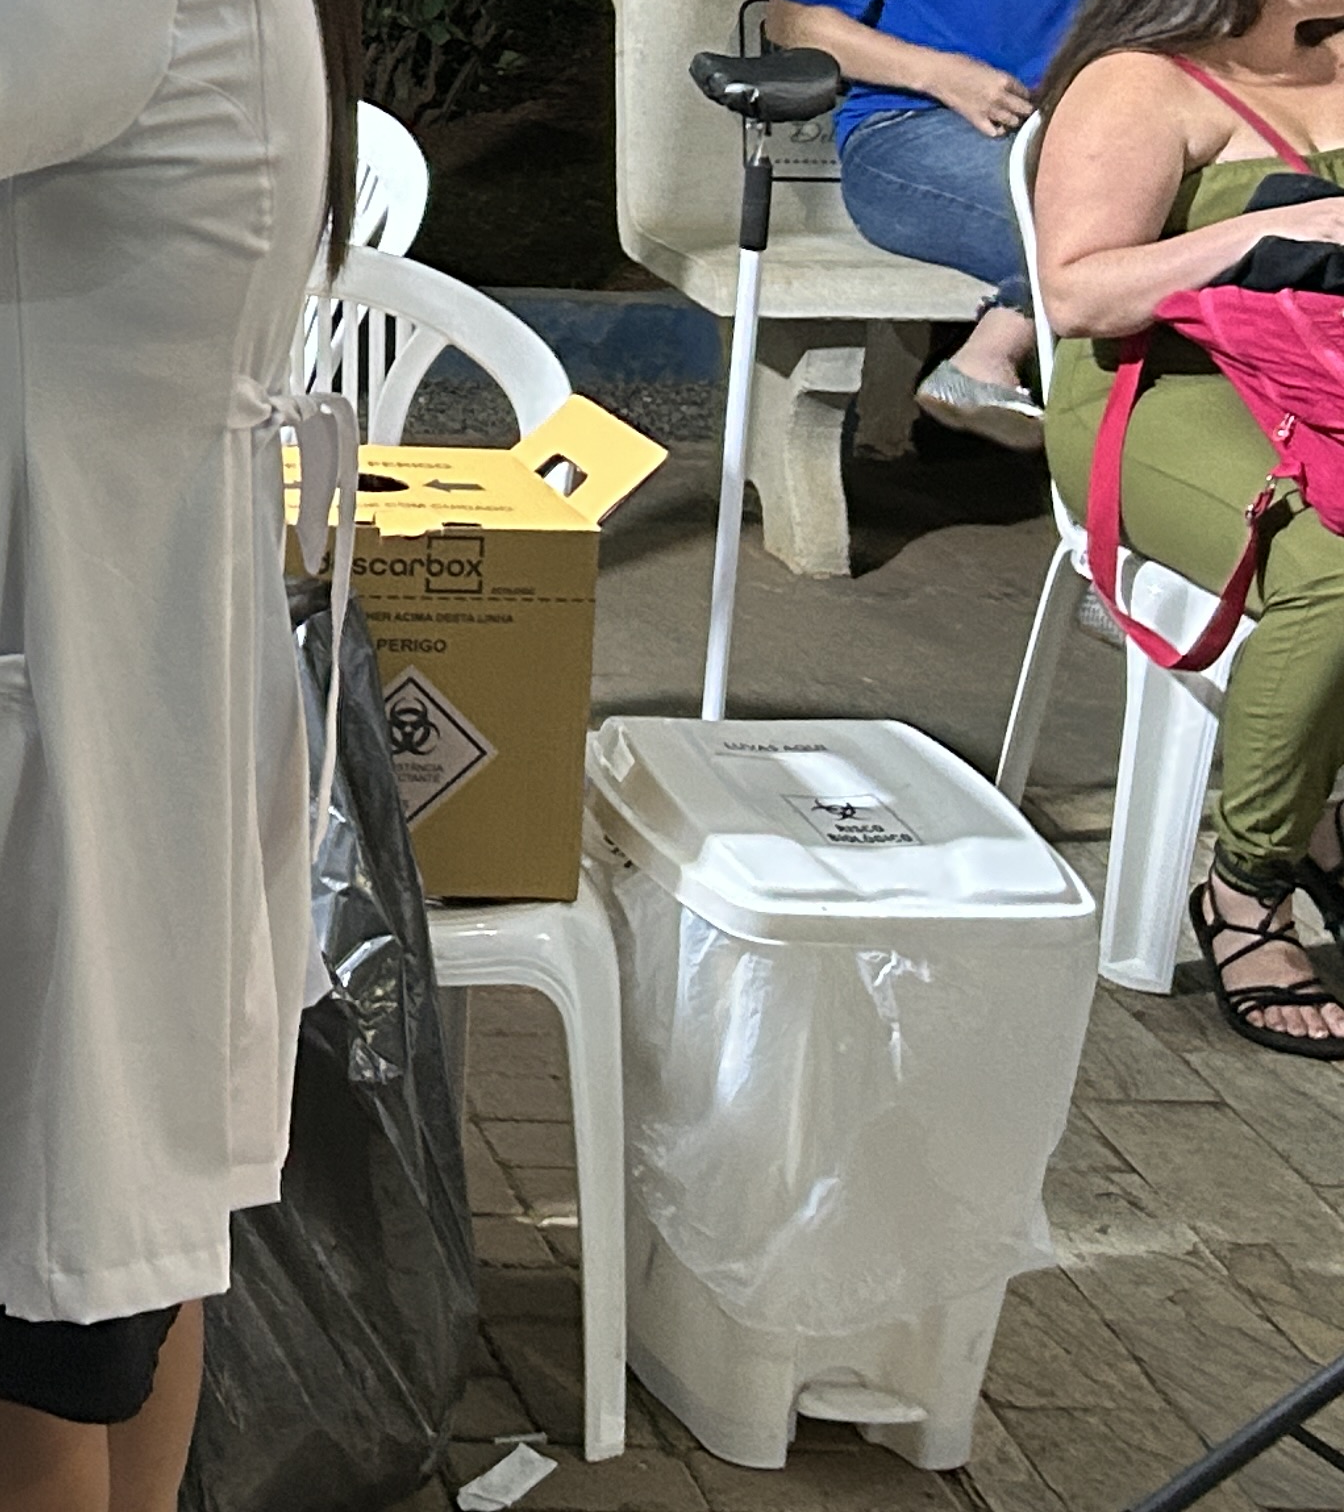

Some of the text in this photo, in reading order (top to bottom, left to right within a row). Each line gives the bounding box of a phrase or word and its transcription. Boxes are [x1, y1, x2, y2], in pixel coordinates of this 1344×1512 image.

[318, 550, 483, 578] dscarbox
[394, 612, 433, 623] ACIMA
[377, 639, 447, 653] PERIGO
